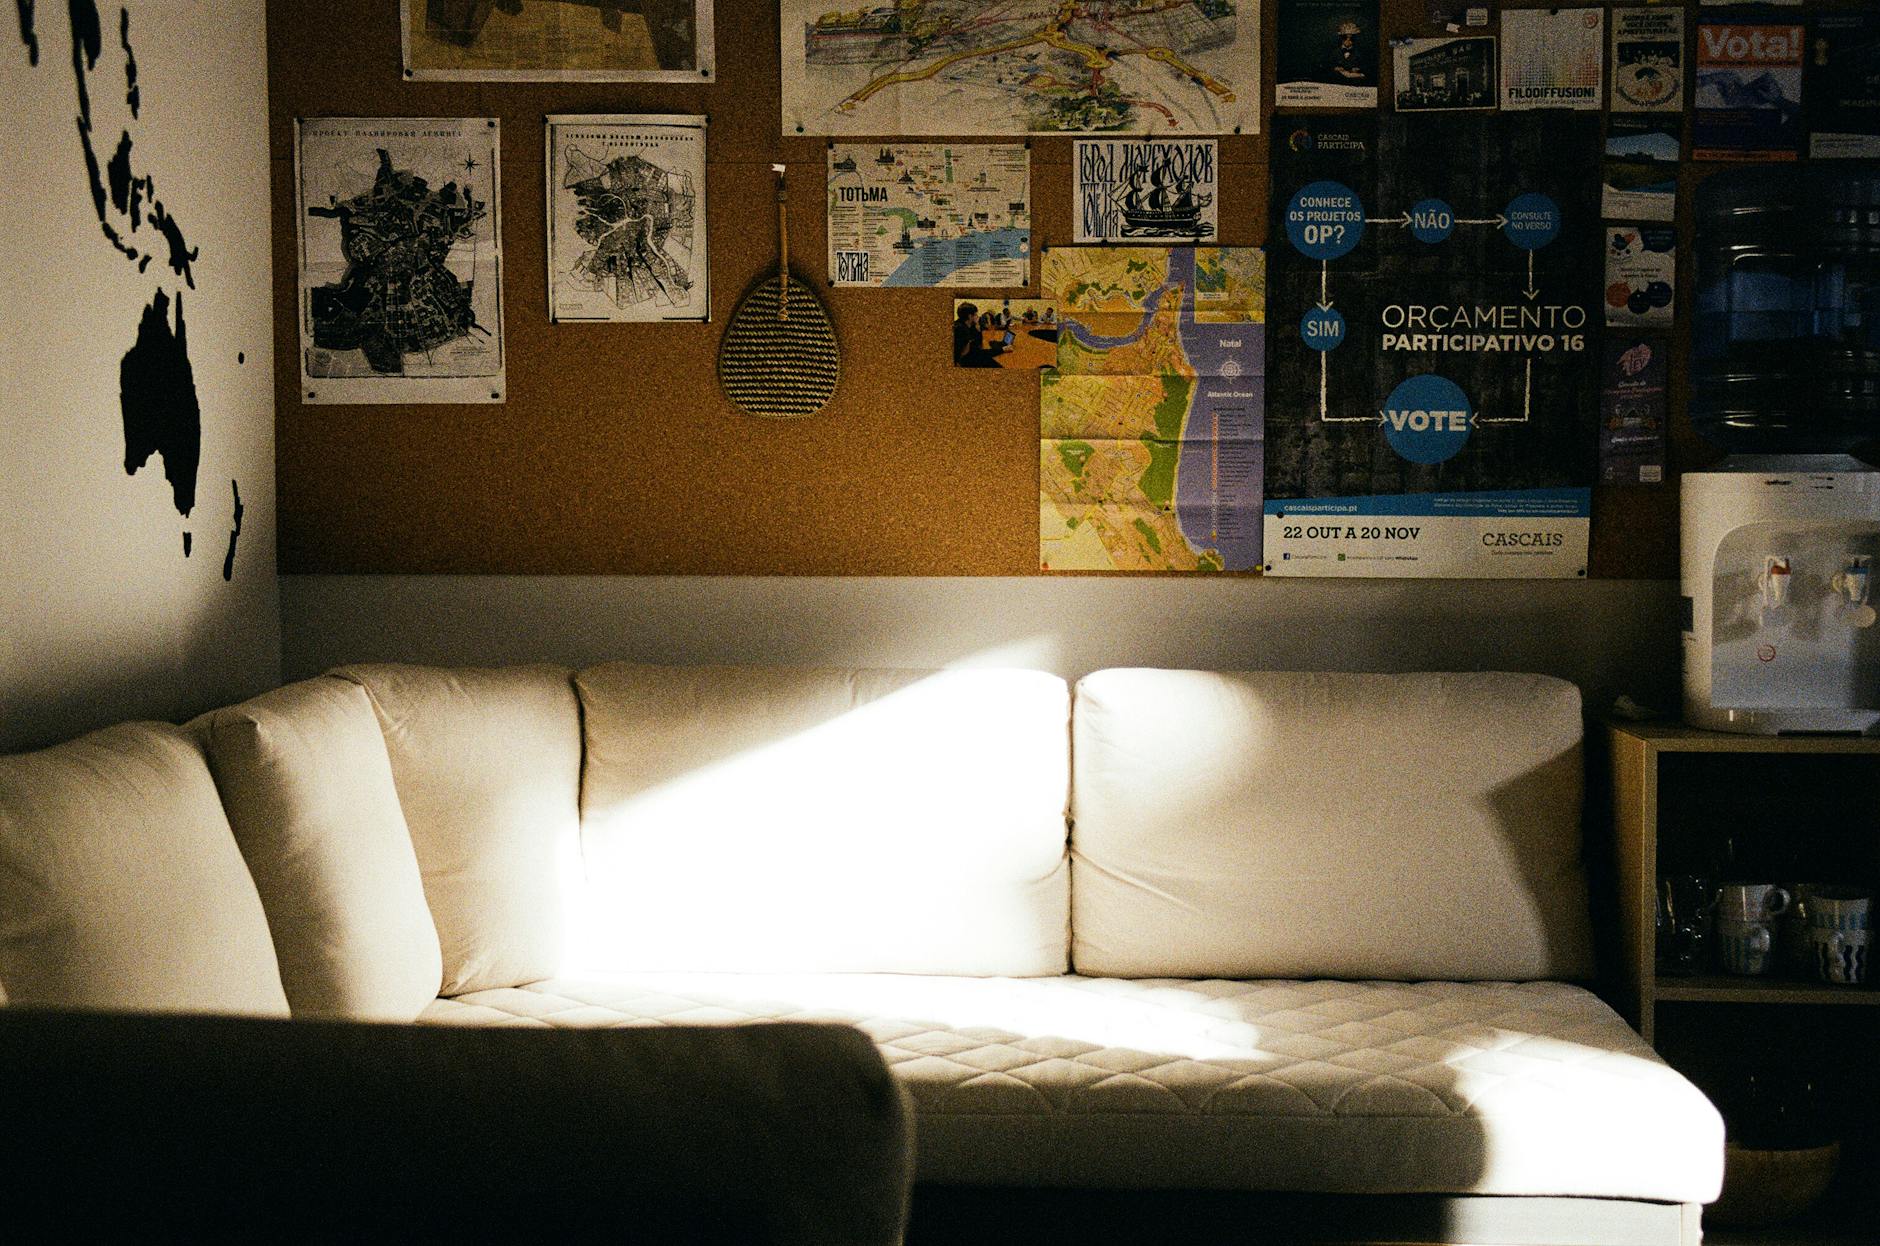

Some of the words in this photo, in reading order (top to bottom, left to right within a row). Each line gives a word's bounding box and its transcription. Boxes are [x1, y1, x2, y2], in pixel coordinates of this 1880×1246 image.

[1700, 27, 1799, 59] Vota!
[1509, 88, 1595, 98] FILODIFFUSIONI
[1317, 141, 1366, 150] PARTICIPA
[839, 187, 888, 202] ТОТЬМА
[1300, 196, 1352, 208] CONHECE
[1290, 210, 1305, 222] OS
[1306, 210, 1362, 222] PROJETOS
[1414, 210, 1450, 230] NÃO
[1511, 212, 1552, 221] CONSULTE
[1511, 221, 1522, 230] NO
[1525, 221, 1552, 230] VERSO
[1304, 225, 1346, 246] OP?
[1382, 304, 1586, 332] ORÇAMENTO
[1307, 320, 1339, 337] SIM
[1219, 338, 1242, 349] Natal
[1382, 334, 1554, 352] PARTICIPATIVO
[1561, 334, 1585, 352] 16
[1207, 390, 1232, 398] Atlantic
[1234, 390, 1254, 398] Ocean
[1388, 409, 1467, 432] VOTE
[1284, 504, 1358, 513] cascaisparticipa.pt
[1284, 526, 1302, 539] 22
[1307, 526, 1341, 539] OUT
[1345, 527, 1356, 539] A
[1361, 527, 1380, 539] 20
[1385, 528, 1420, 540] NOV
[1482, 533, 1563, 546] CASCAIS
